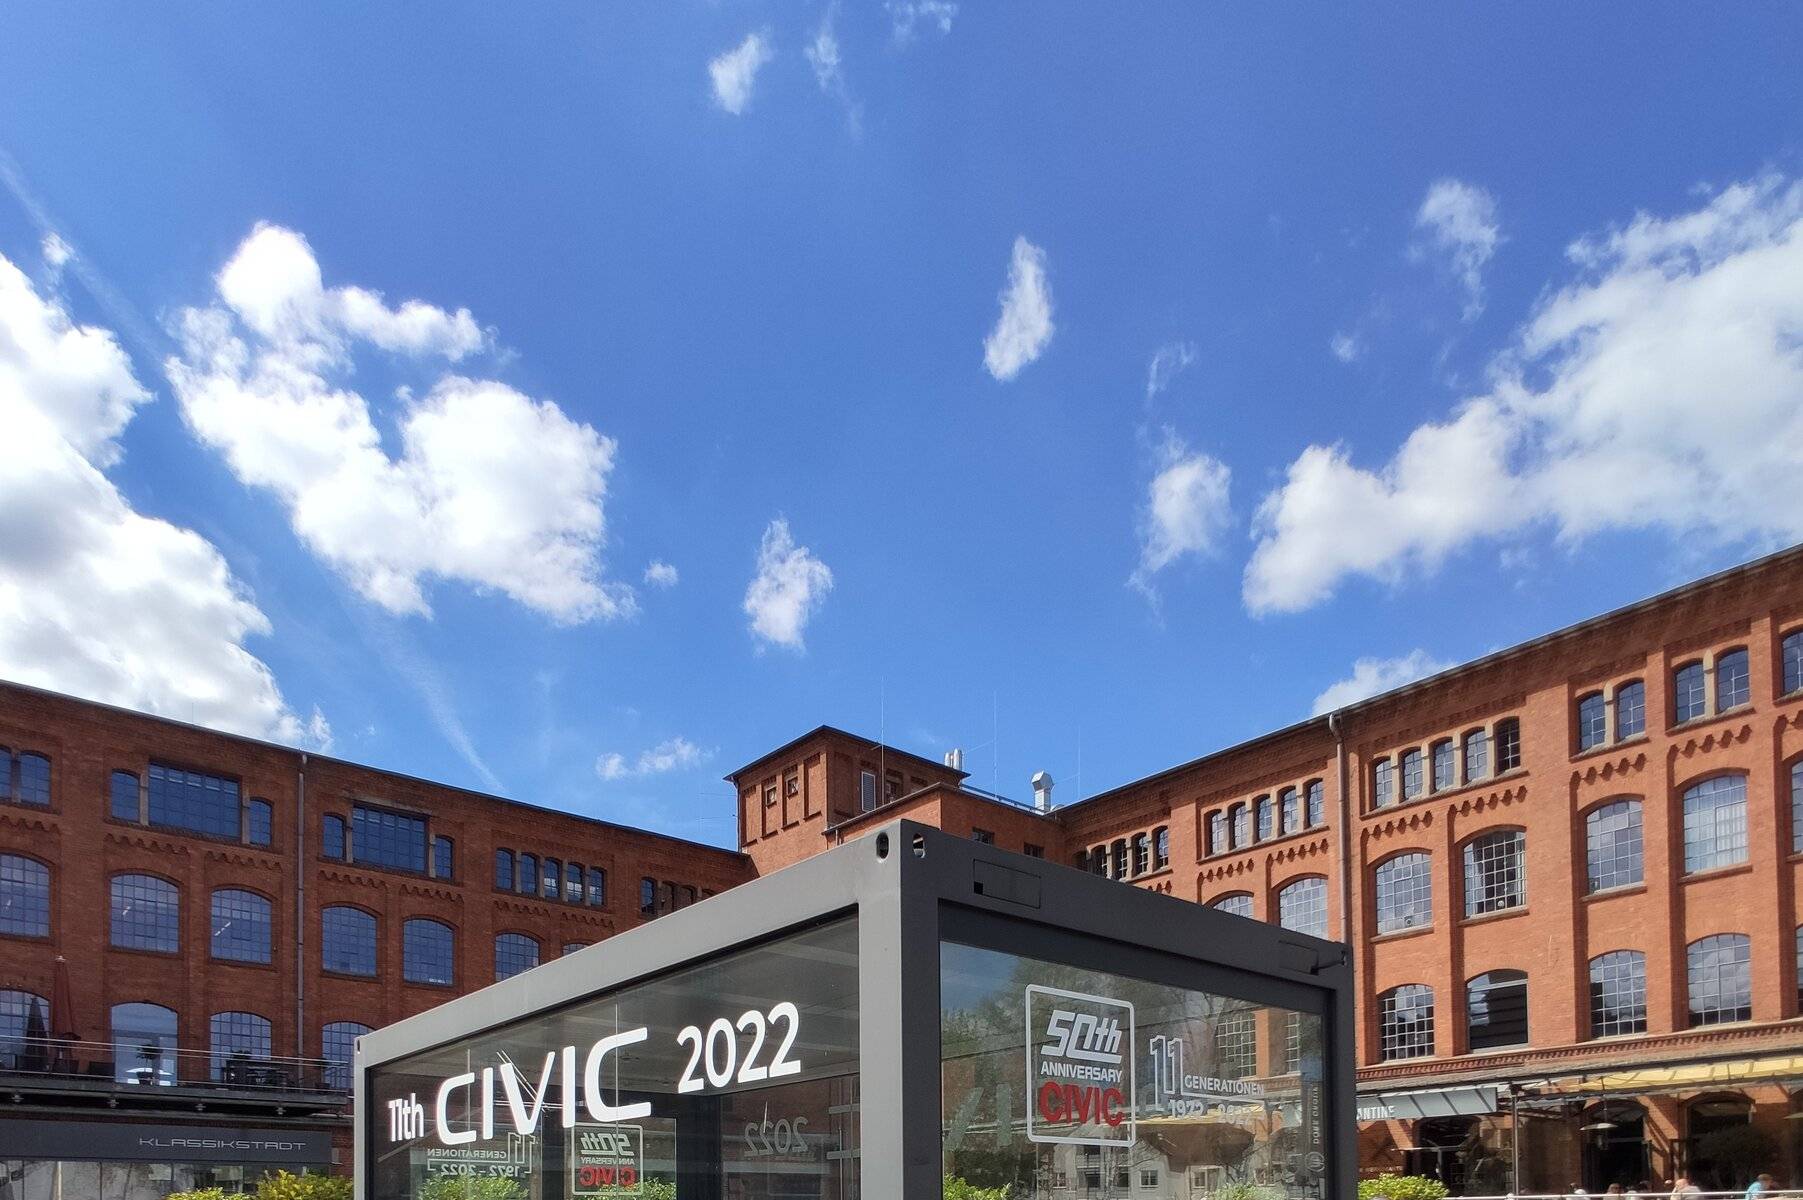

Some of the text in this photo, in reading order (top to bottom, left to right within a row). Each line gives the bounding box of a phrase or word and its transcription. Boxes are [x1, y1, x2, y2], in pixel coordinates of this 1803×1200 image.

[1040, 1009, 1123, 1064] 50th
[388, 1001, 802, 1146] 11th CIVIC 2022
[1040, 1061, 1122, 1083] ANNIVERSARY
[1149, 1034, 1265, 1112] 11 GENERATIONEN
[1038, 1080, 1125, 1127] CIVIC
[139, 1138, 306, 1150] KLASSIKSTADT
